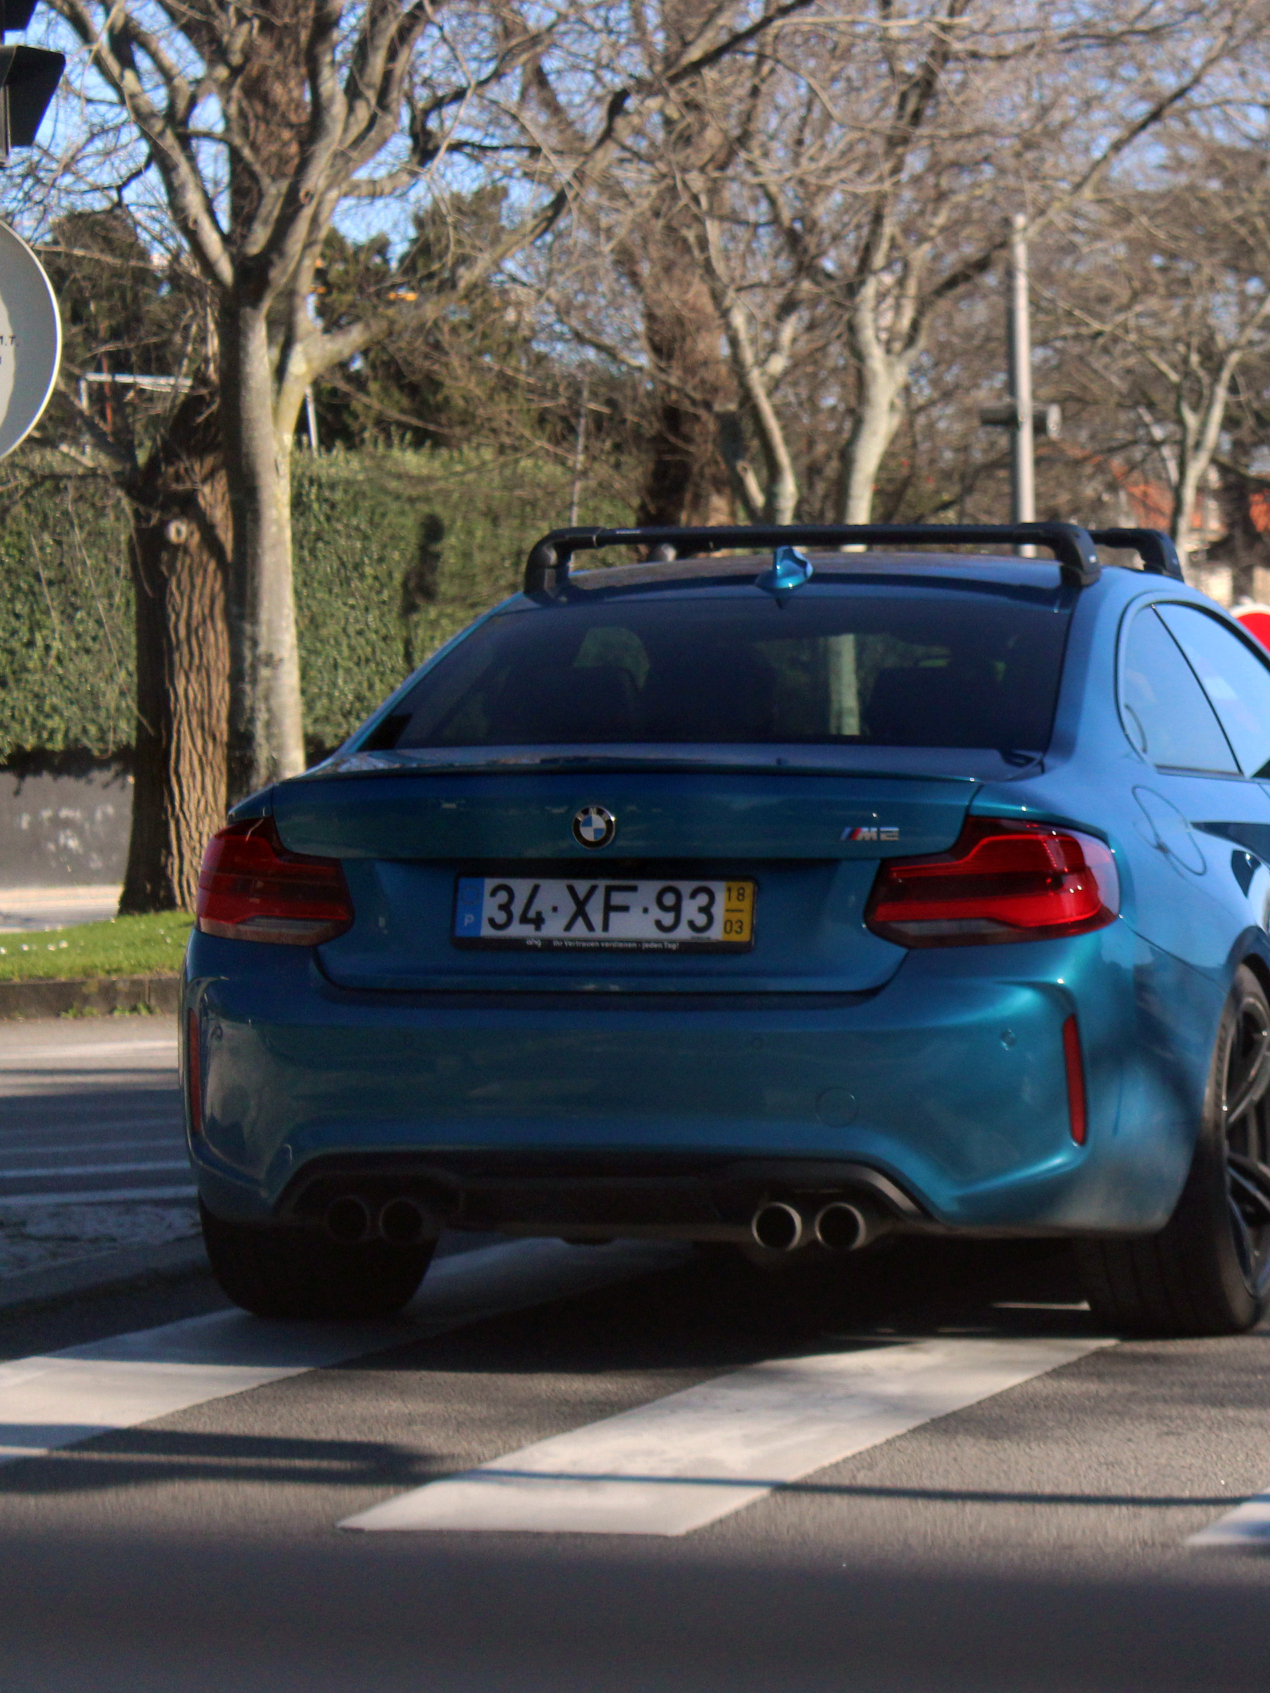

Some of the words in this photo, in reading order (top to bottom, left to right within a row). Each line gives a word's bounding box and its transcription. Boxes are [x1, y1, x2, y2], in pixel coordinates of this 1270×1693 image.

[855, 826, 900, 841] M2
[726, 886, 746, 902] 18
[723, 919, 744, 935] 03
